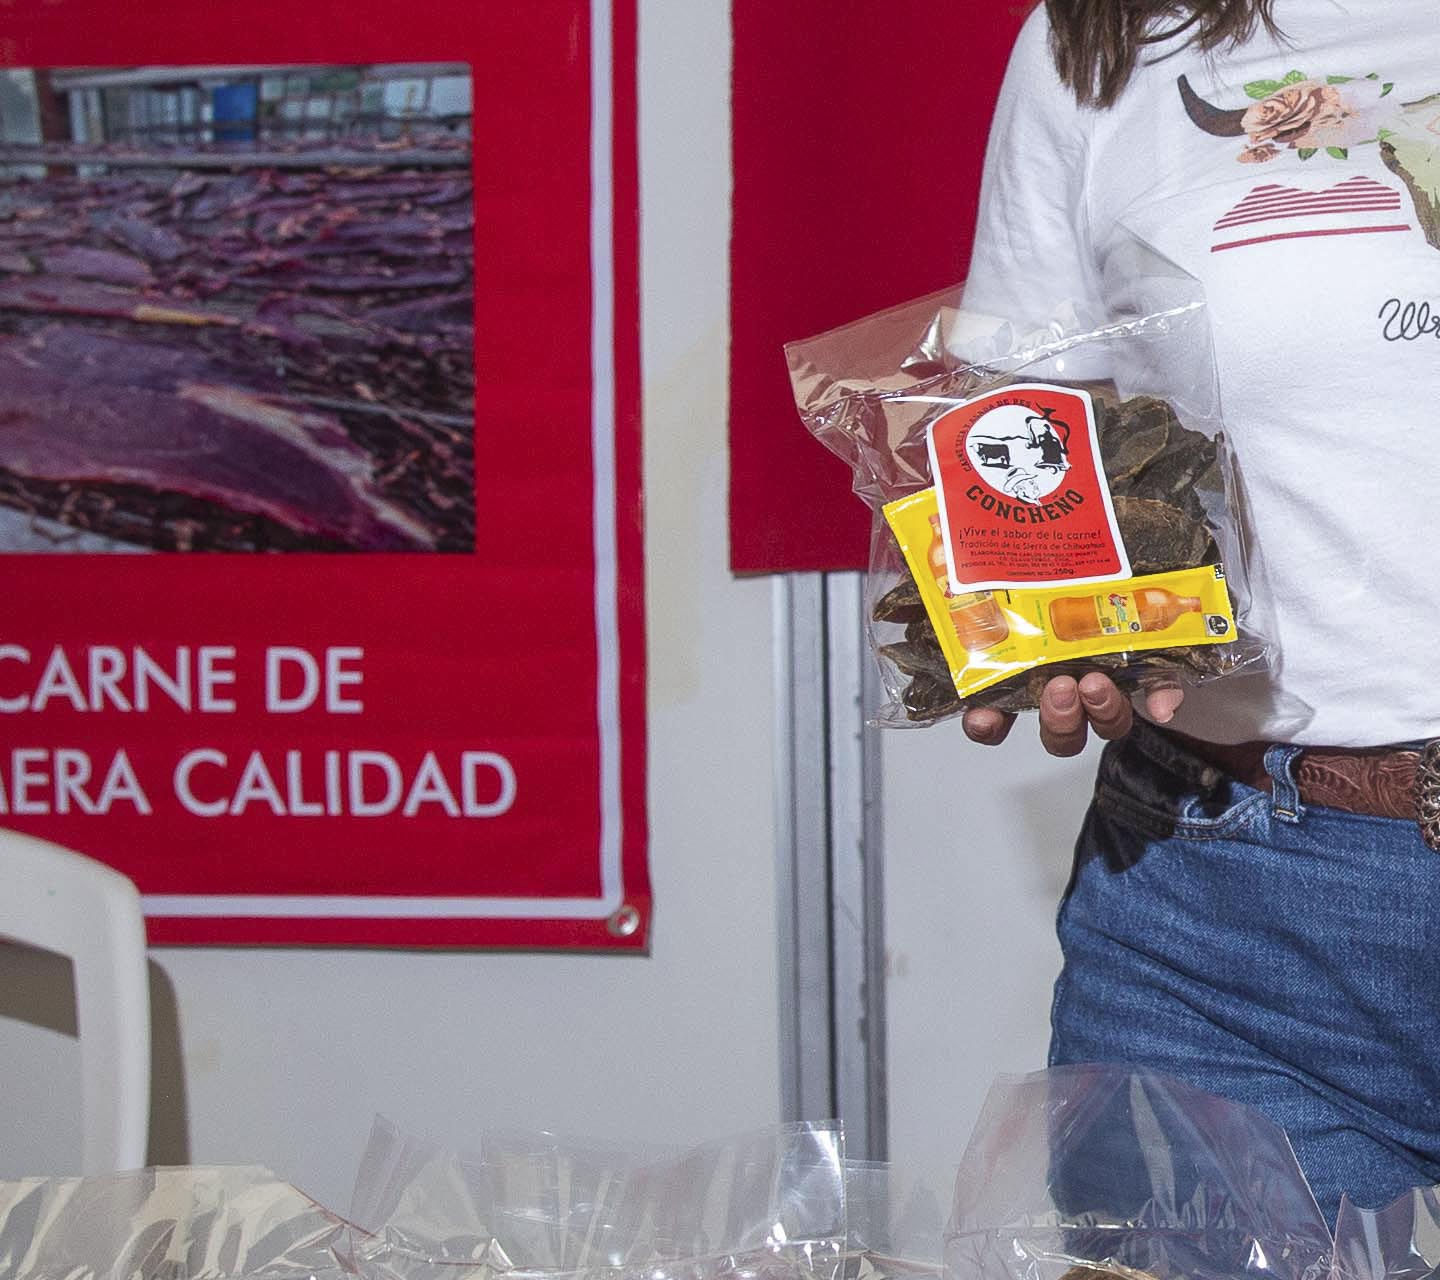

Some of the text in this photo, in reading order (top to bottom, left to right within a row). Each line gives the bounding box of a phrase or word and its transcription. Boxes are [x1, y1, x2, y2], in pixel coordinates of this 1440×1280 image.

[965, 484, 1084, 524] CONCHEÑO
[991, 528, 999, 536] el
[1003, 530, 1032, 539] sabor
[1037, 530, 1049, 539] de
[1054, 530, 1063, 539] la
[1067, 531, 1101, 539] carne!
[266, 646, 363, 713] DE
[174, 748, 517, 817] CALIDAD
